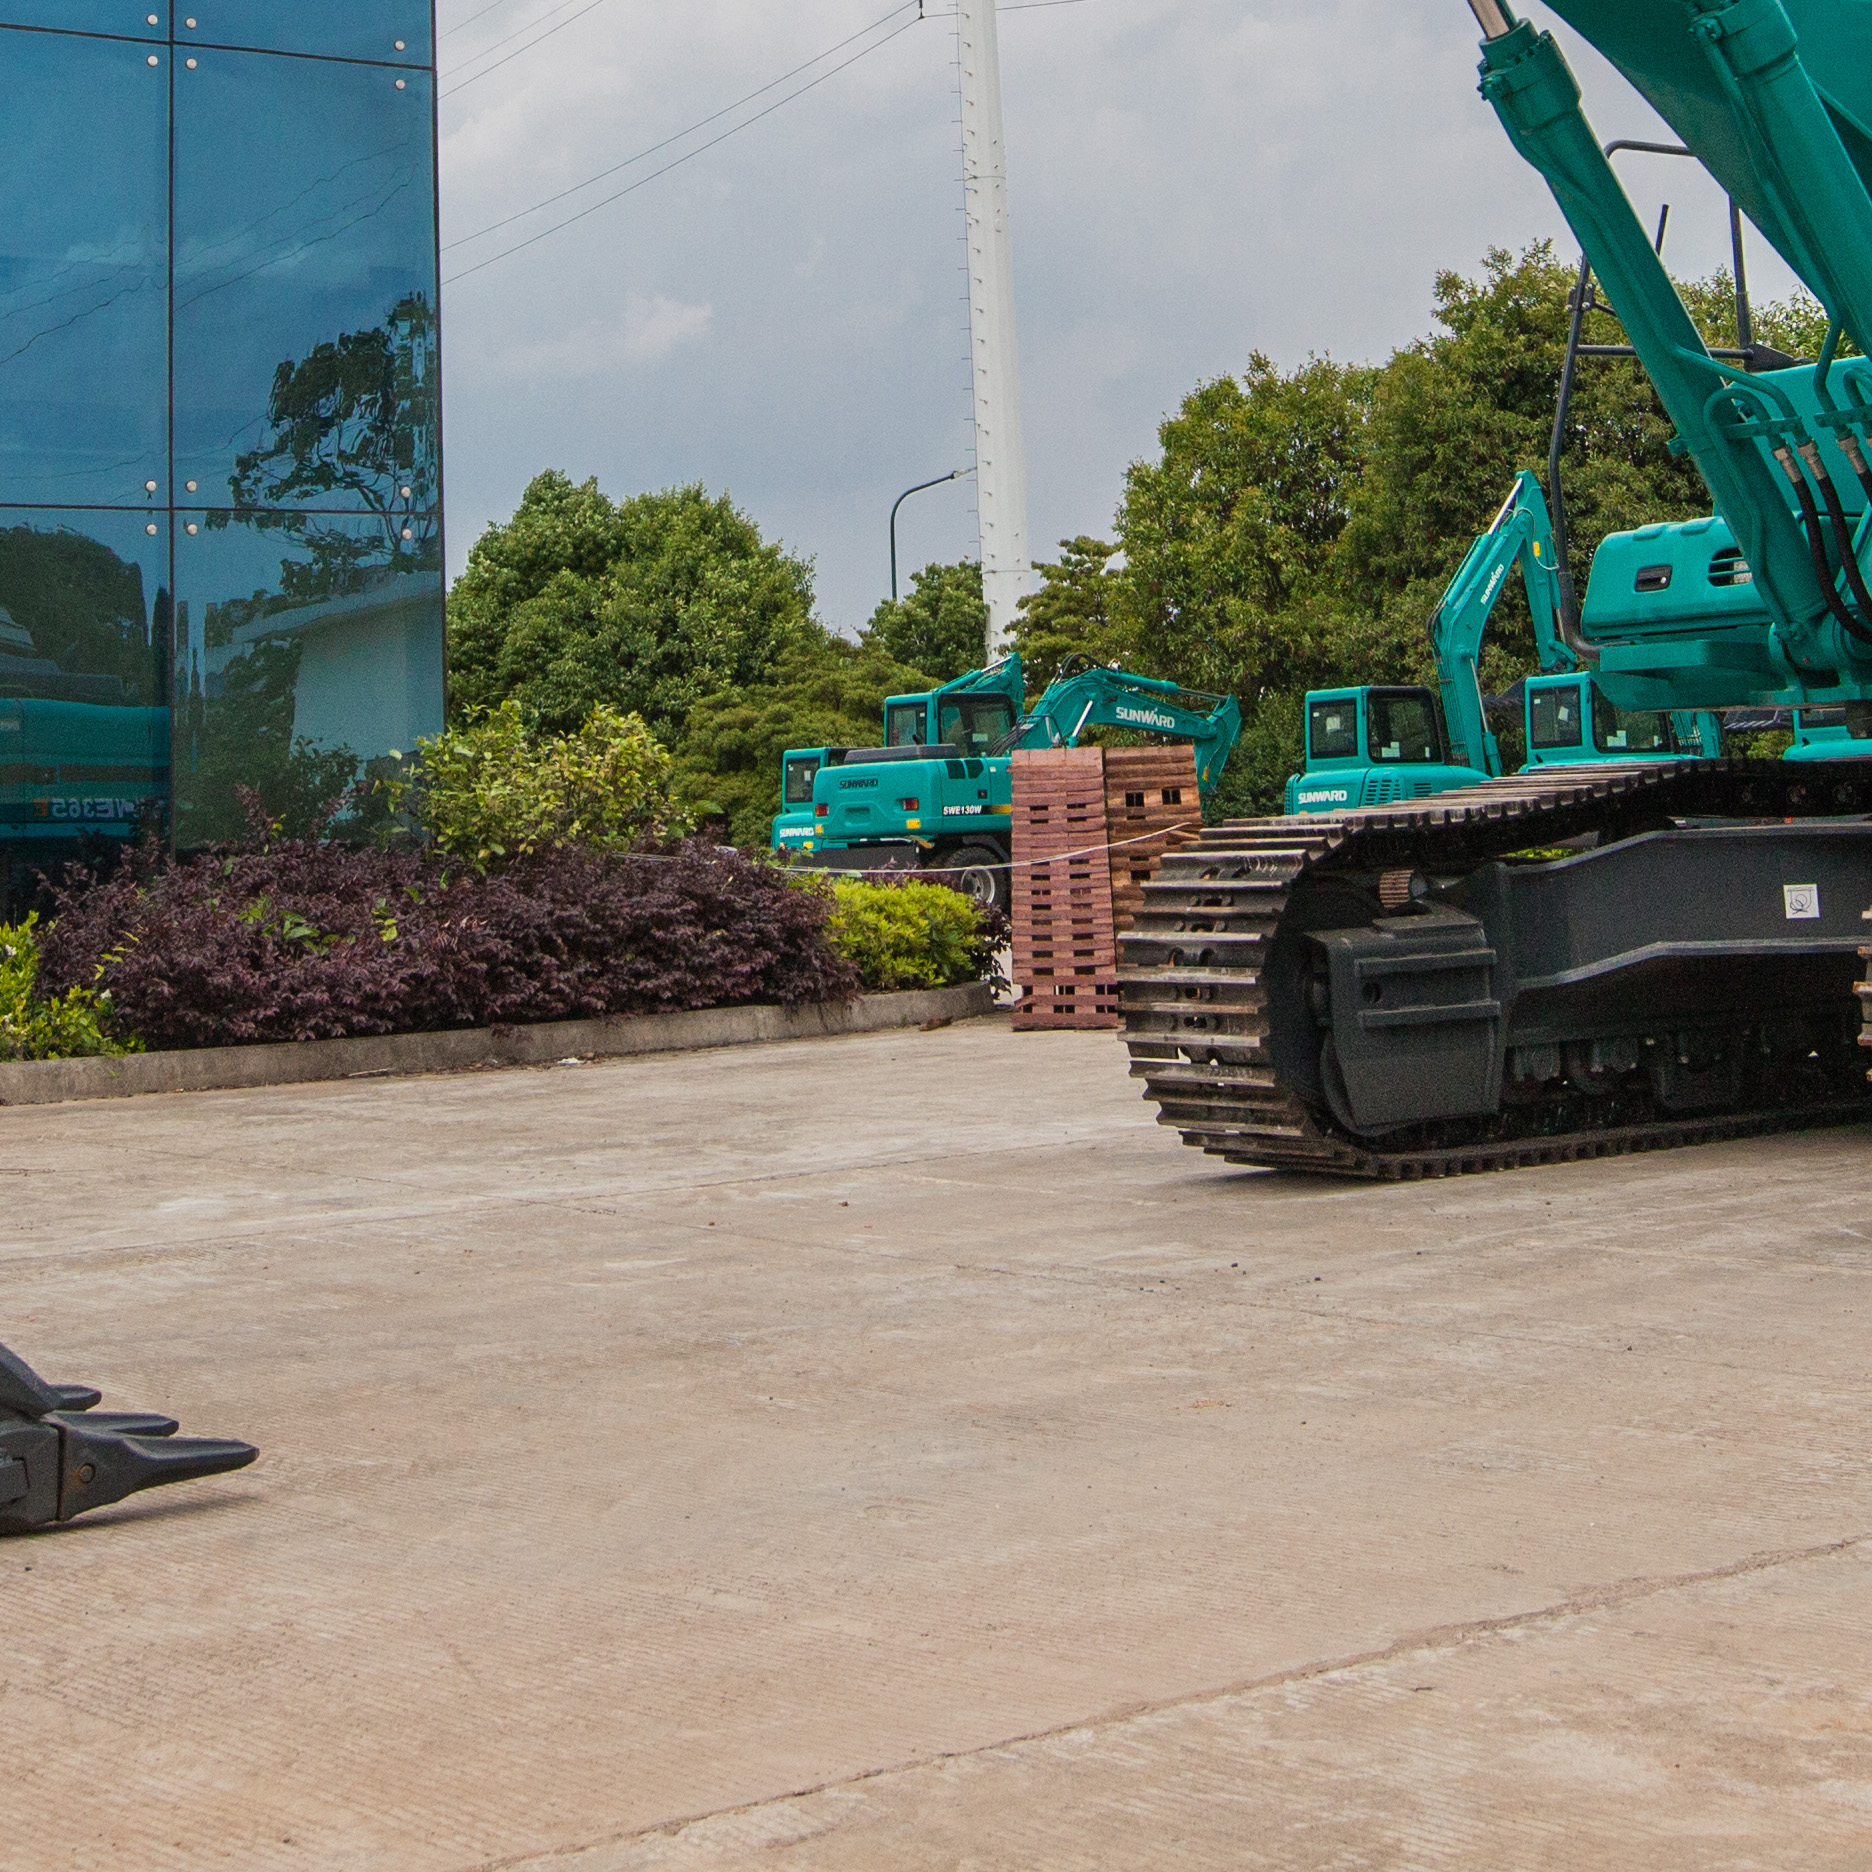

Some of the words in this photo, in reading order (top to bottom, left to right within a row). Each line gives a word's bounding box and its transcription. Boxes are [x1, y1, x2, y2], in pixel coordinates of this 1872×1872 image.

[1116, 707, 1175, 729] SUNWARD
[1298, 789, 1347, 804] SUNWARD
[943, 804, 982, 816] SWE130W
